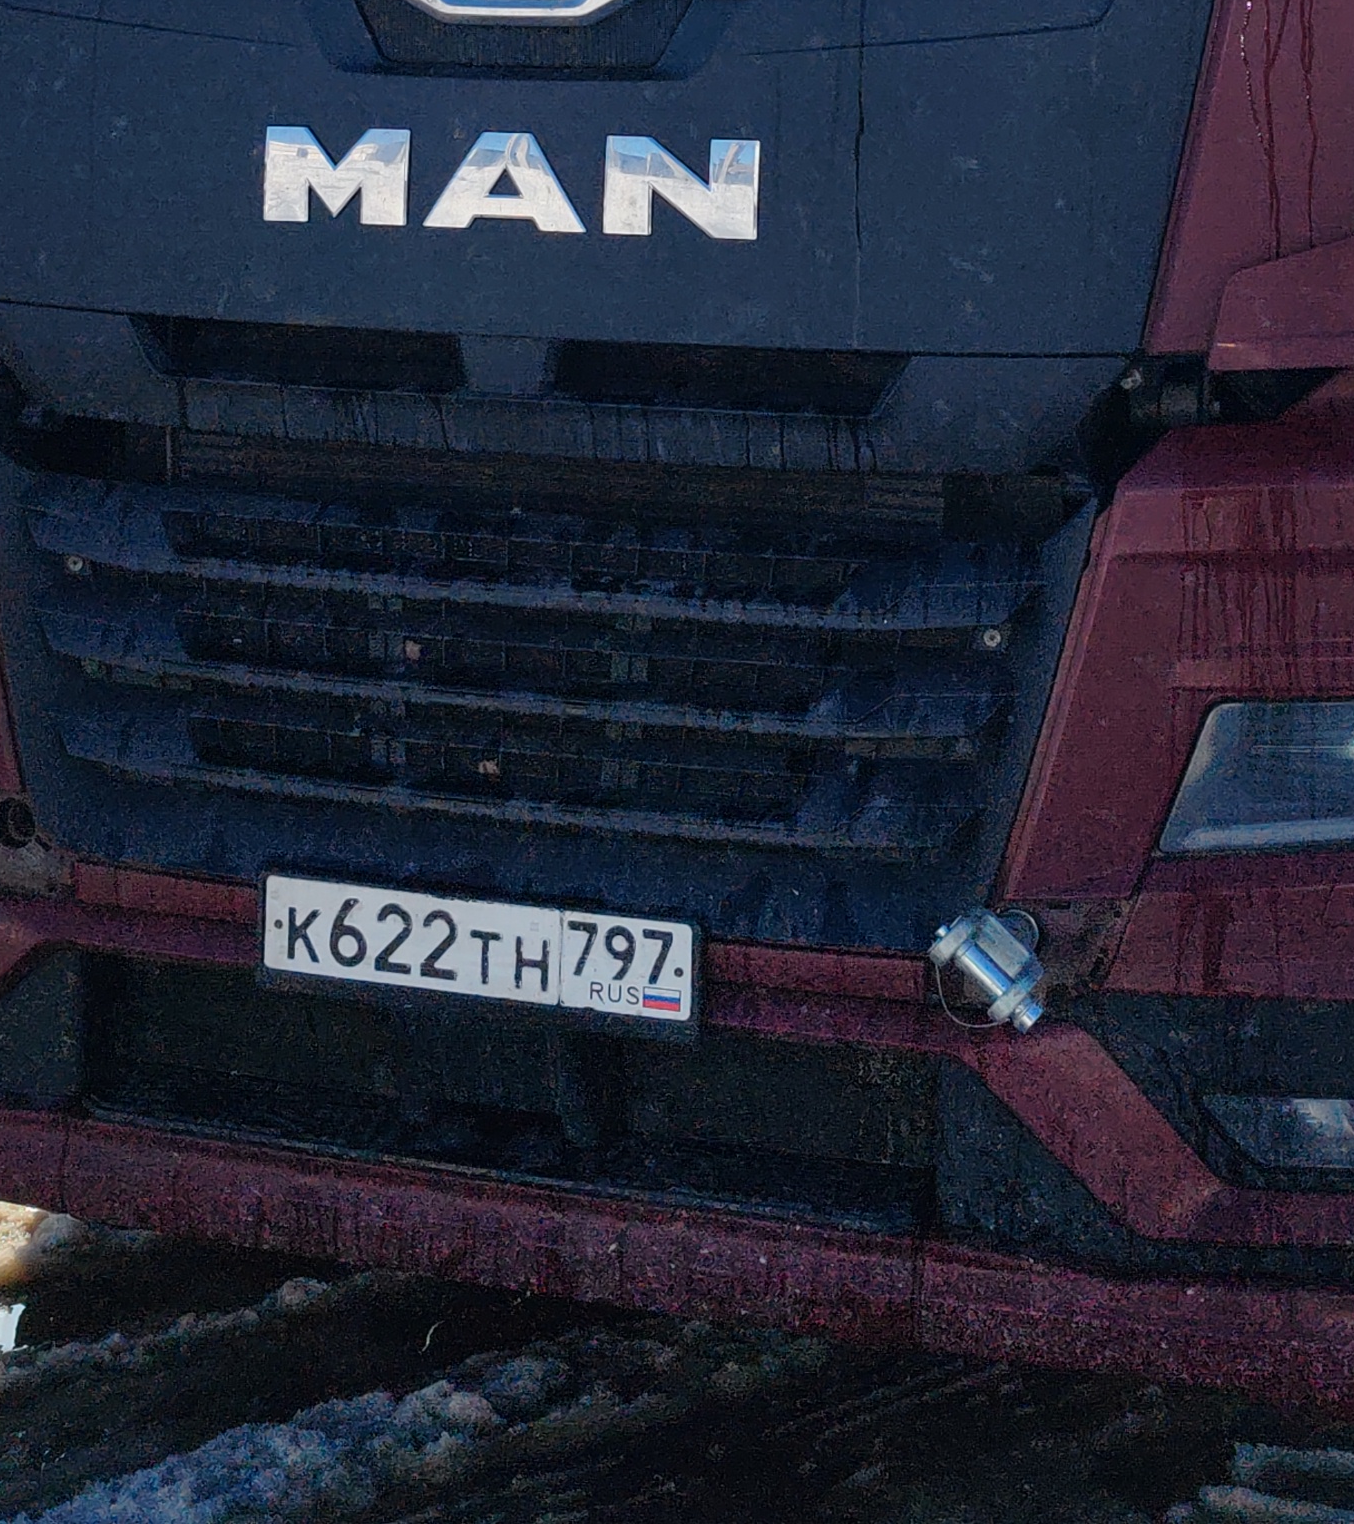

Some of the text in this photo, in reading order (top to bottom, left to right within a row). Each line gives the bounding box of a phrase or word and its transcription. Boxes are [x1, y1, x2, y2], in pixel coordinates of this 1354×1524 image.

[262, 124, 761, 241] MAN
[567, 920, 675, 986] 797
[589, 981, 640, 1007] RUS
